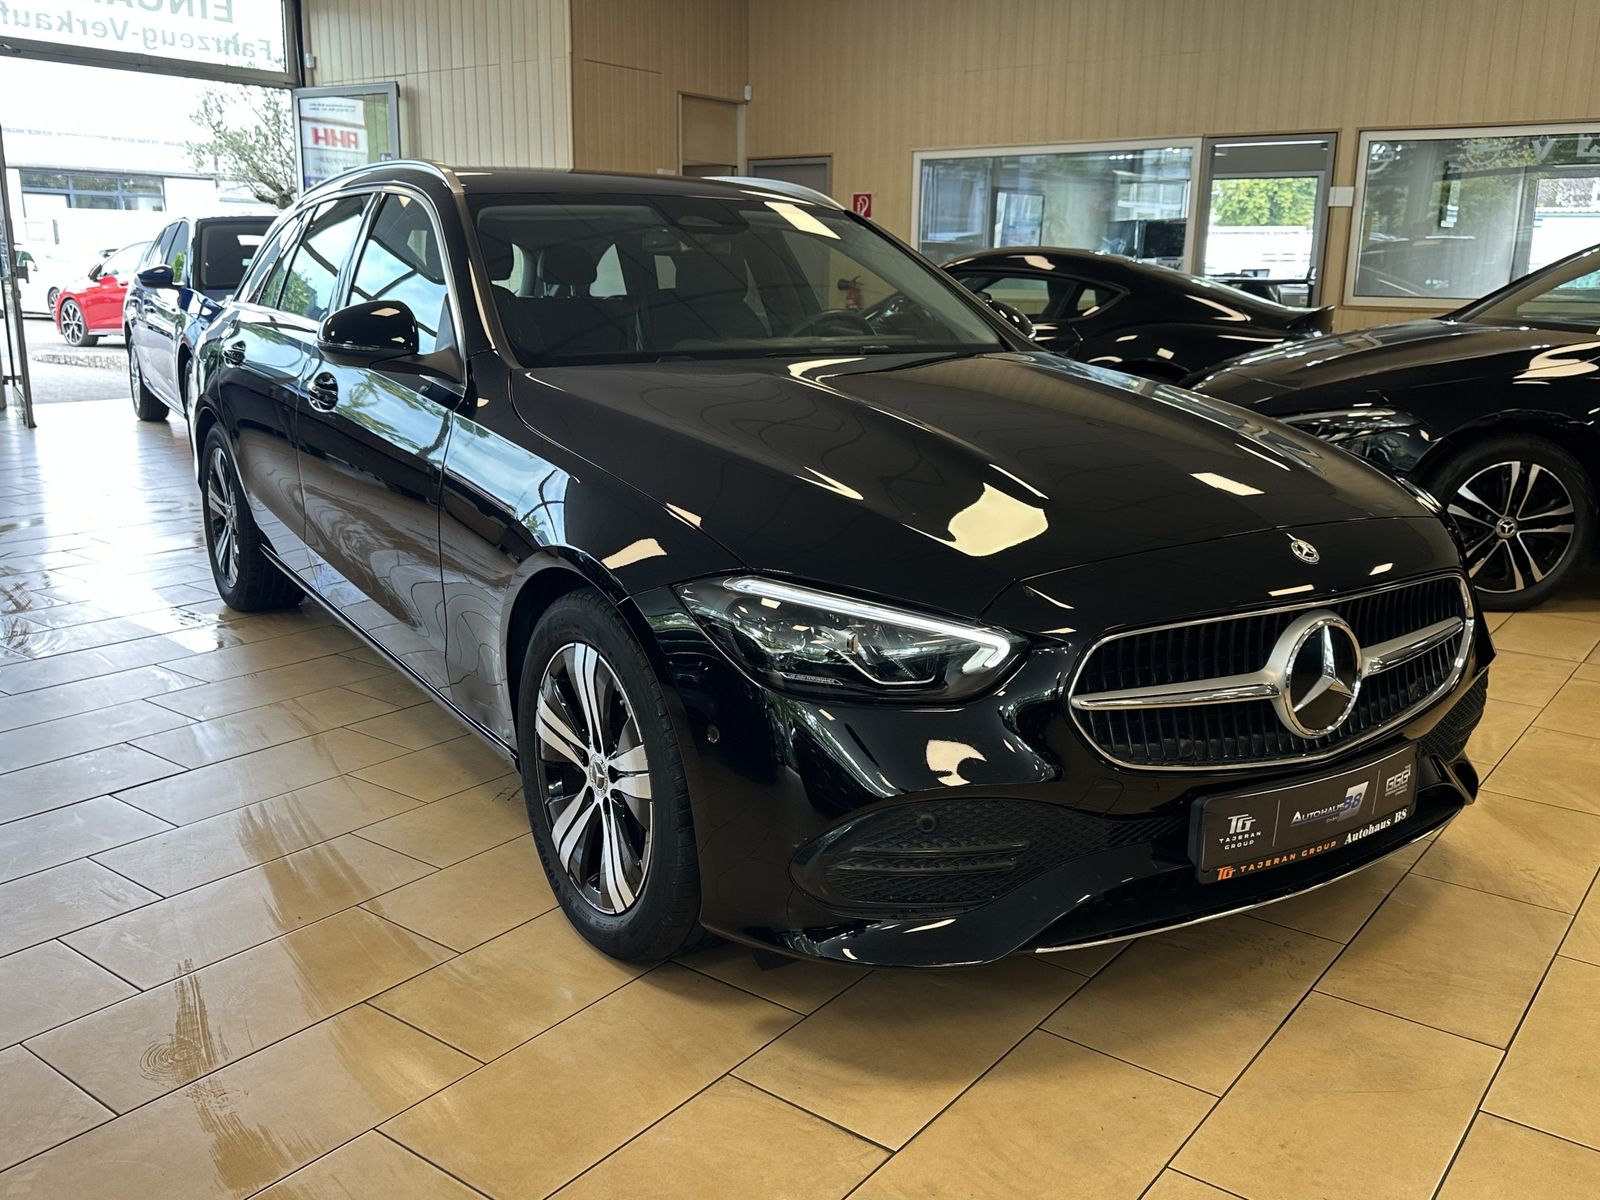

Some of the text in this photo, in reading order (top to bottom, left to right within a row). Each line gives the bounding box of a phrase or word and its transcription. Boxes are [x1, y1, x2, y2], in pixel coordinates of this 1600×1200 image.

[1219, 831, 1262, 844] TAJERAN
[1344, 818, 1391, 845] Autohaus
[1224, 839, 1255, 850] GROUP
[1240, 853, 1296, 873] TAJERAN
[1301, 840, 1337, 857] GROUP
